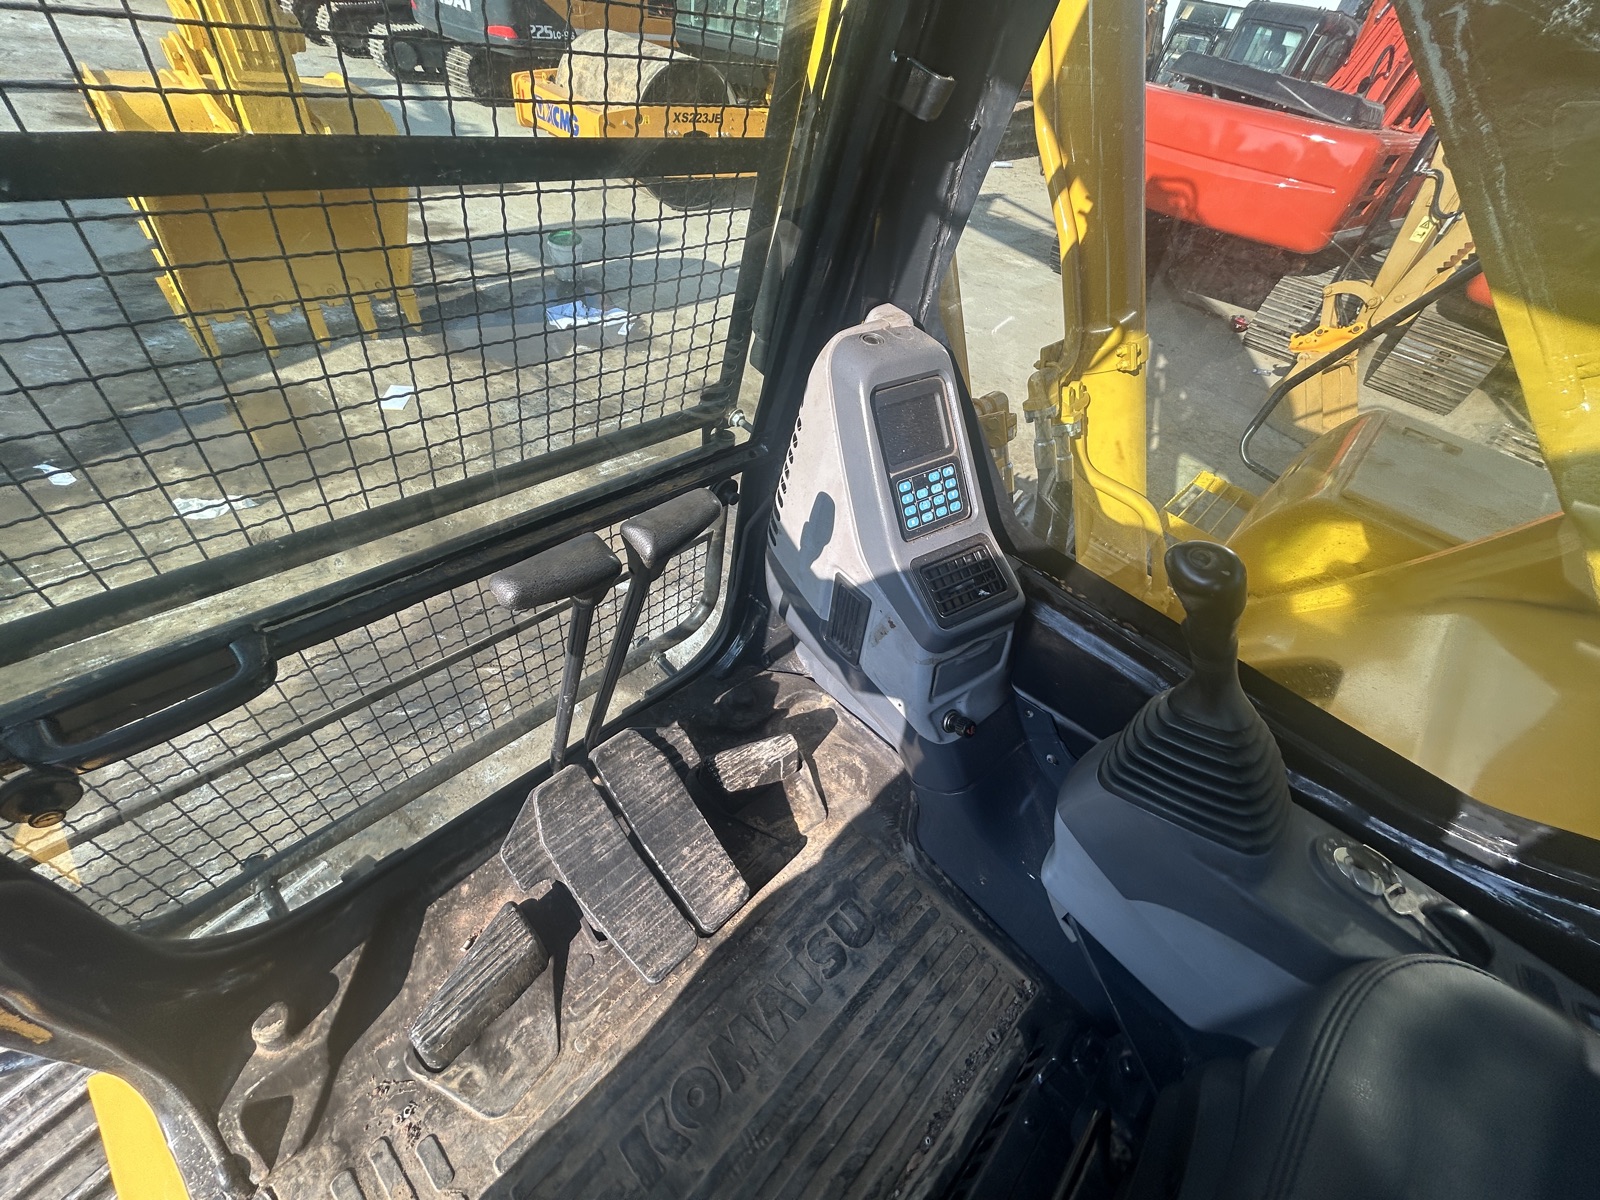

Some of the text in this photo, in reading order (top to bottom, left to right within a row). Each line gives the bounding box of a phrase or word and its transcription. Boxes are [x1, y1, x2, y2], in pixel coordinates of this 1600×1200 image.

[545, 102, 580, 136] XCMG
[672, 112, 722, 124] XS223JE
[618, 898, 876, 1194] KOMATSU
